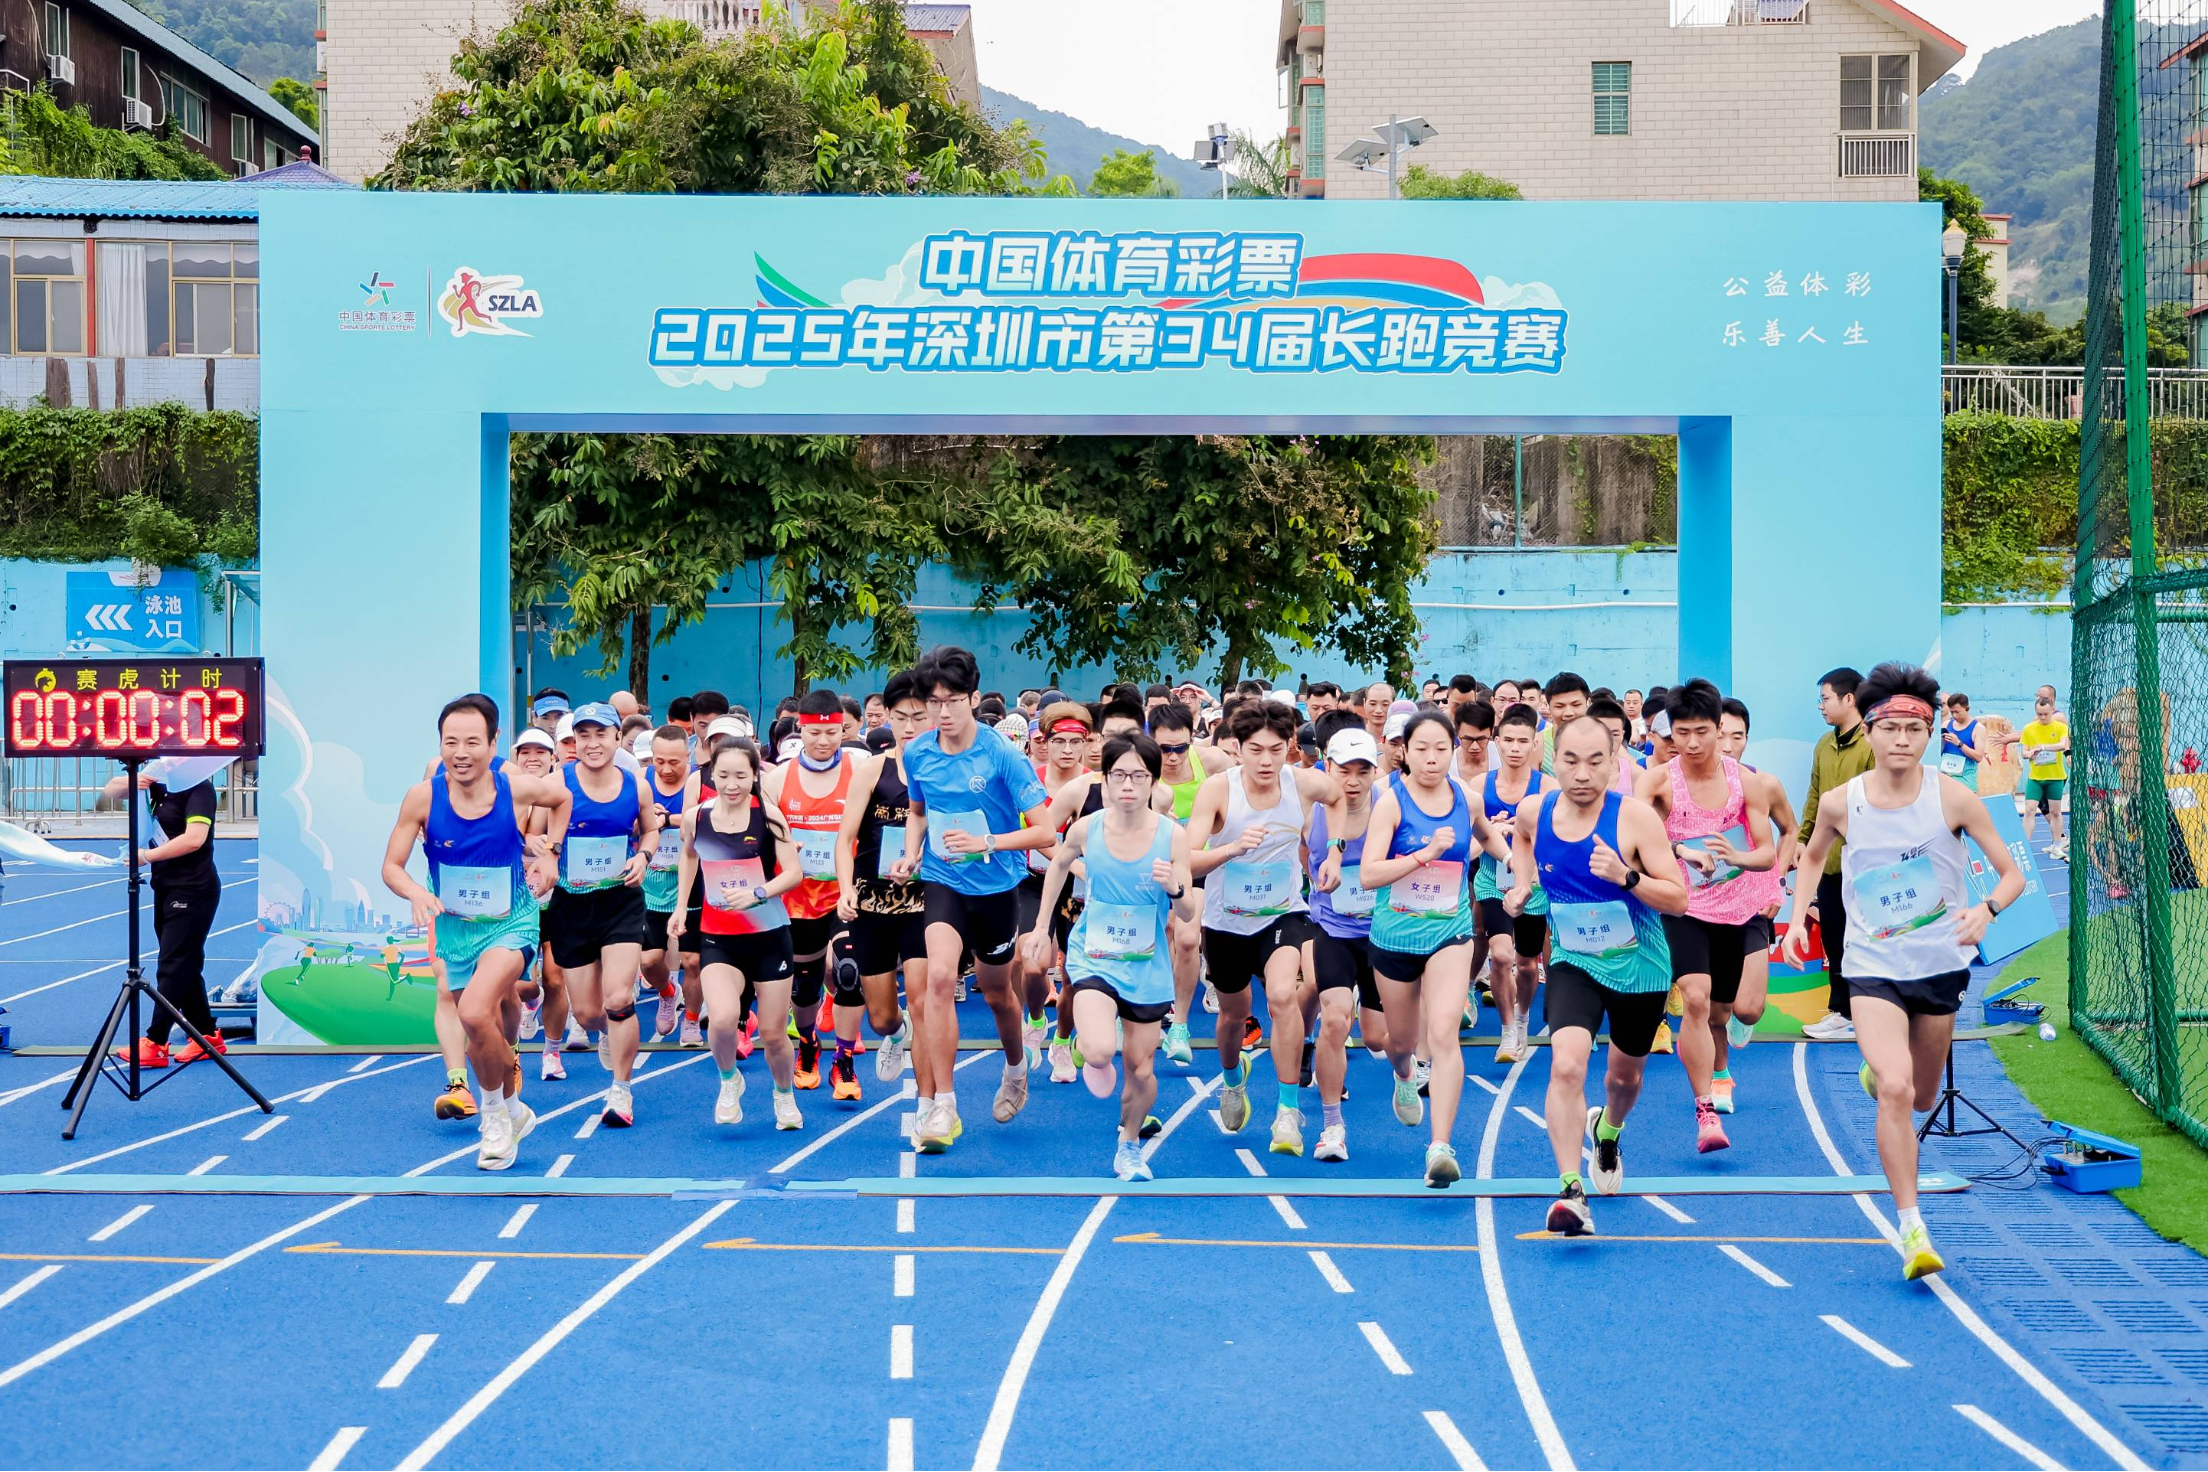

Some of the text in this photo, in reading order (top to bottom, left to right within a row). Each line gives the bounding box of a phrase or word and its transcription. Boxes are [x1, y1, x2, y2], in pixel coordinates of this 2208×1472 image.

[923, 233, 1299, 294] 中国体育彩票
[1722, 269, 1872, 297] 公益体彩
[488, 295, 537, 312] SZLA
[339, 310, 415, 323] 中国体育彩票
[653, 308, 1562, 369] 2025年深圳市第34届长跑竞赛
[1722, 318, 1869, 347] 乐善人生
[145, 595, 182, 615] 泳池
[145, 619, 182, 639] 入口
[77, 668, 222, 690] 赛虎计时
[12, 690, 244, 747] 00:00:02
[458, 889, 491, 899] 男子组
[1880, 888, 1918, 907] 男子组
[1891, 902, 1914, 915] M166
[1107, 926, 1137, 937] 男子组
